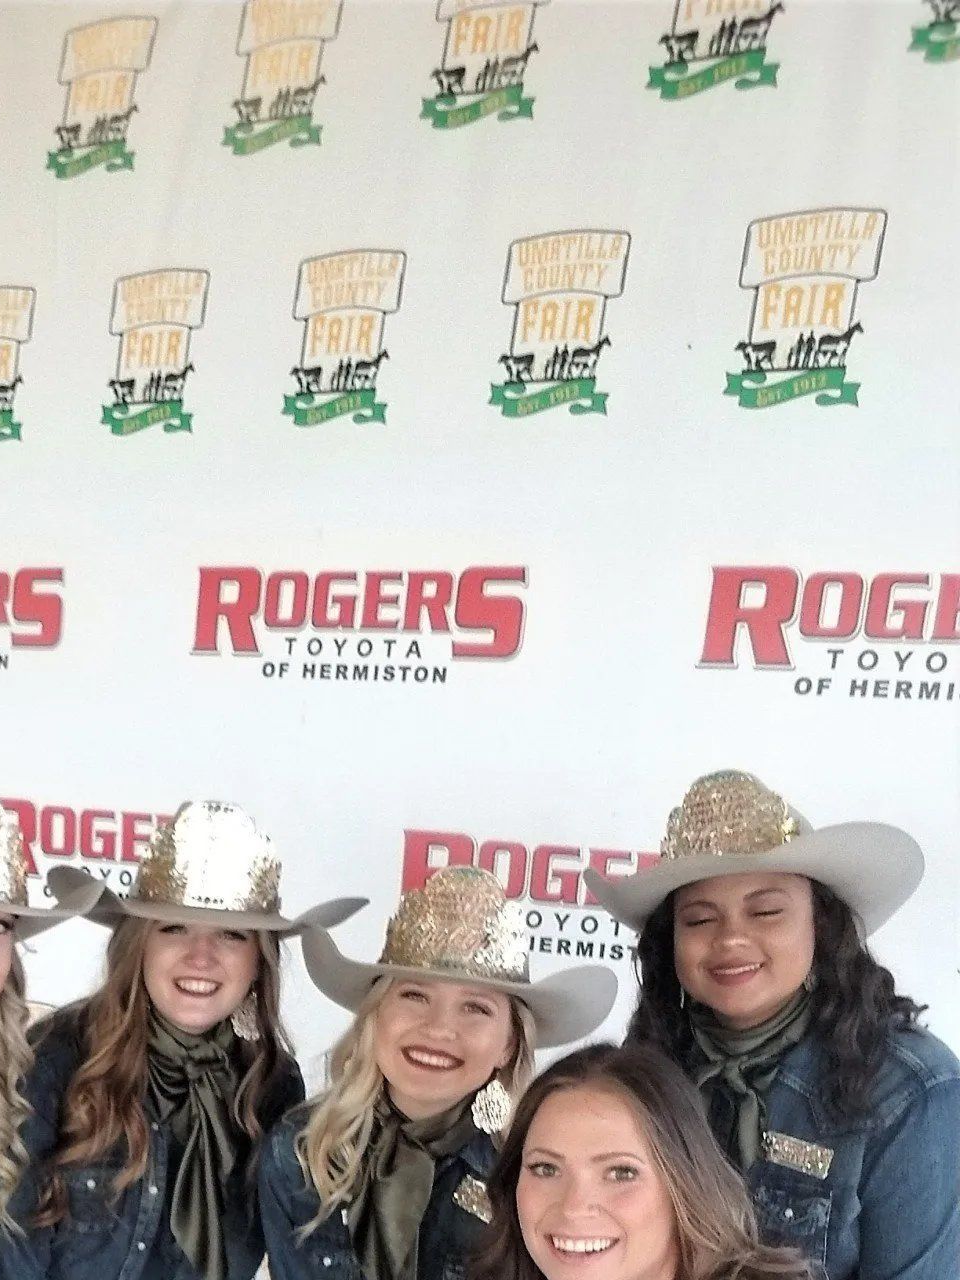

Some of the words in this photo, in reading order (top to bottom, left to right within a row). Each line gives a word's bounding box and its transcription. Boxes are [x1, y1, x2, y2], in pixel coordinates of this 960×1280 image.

[452, 8, 526, 57] FAIR
[758, 211, 879, 249] UMATILLA
[518, 233, 623, 267] UMATILLA
[764, 244, 860, 277] COUNTY
[522, 262, 609, 292] COUNTY
[521, 299, 596, 343] FAIR
[762, 282, 846, 329] FAIR
[310, 314, 376, 358] FAIR
[191, 565, 530, 661] ROGERS
[284, 637, 423, 660] TOYOTA
[826, 648, 949, 674] TOYO
[262, 662, 290, 679] OF
[301, 663, 448, 684] HERMISTON
[793, 676, 833, 696] OF
[848, 678, 960, 701] HERMI
[401, 829, 662, 906] ROGE
